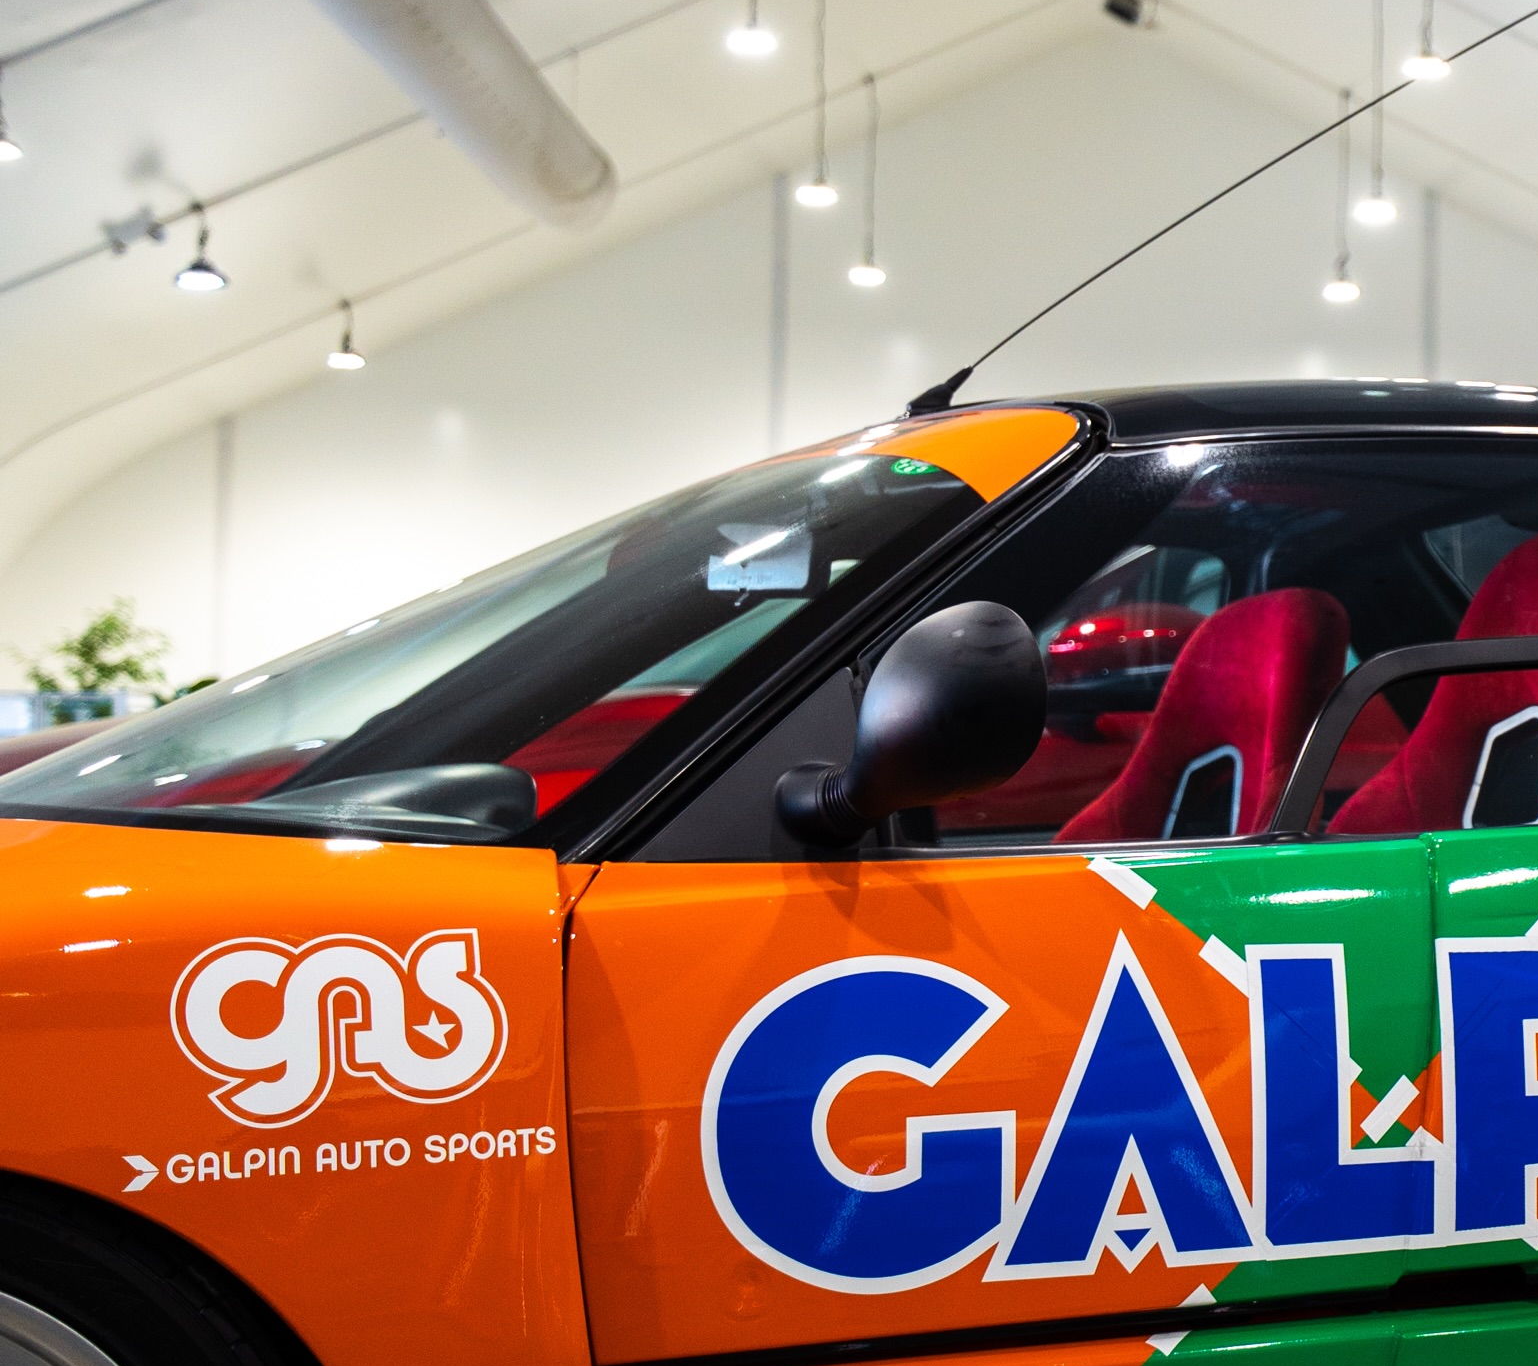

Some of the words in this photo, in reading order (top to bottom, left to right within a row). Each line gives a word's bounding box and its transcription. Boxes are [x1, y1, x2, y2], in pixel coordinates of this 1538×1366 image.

[166, 1146, 301, 1184] GALPIN
[316, 1137, 412, 1172] AUTO
[424, 1126, 557, 1164] SPORTS
